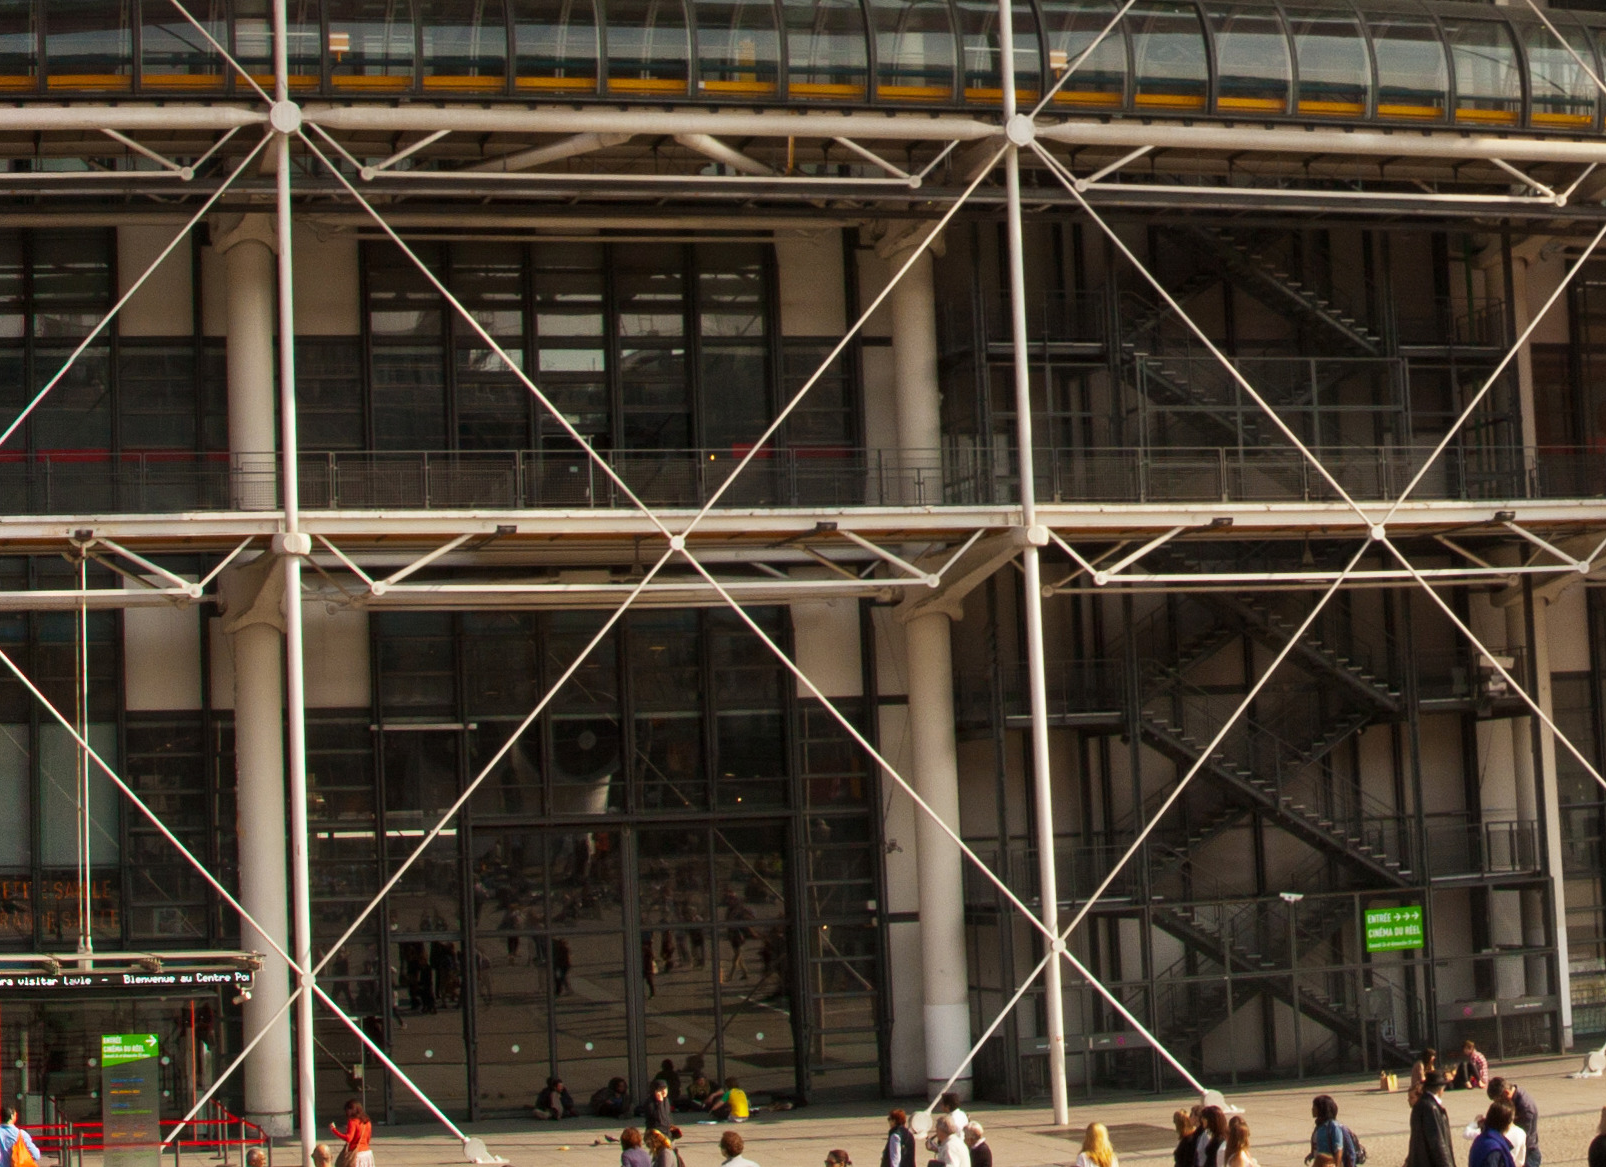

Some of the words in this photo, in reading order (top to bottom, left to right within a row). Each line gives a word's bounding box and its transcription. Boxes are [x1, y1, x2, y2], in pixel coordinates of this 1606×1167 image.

[1367, 912, 1392, 924] ENTRÉE
[1368, 926, 1393, 938] CINÉMA
[1394, 926, 1404, 936] DU
[1405, 924, 1421, 935] RÉEL
[17, 976, 58, 986] visitar
[123, 974, 175, 984] Bienvenue
[196, 973, 231, 983] Centre
